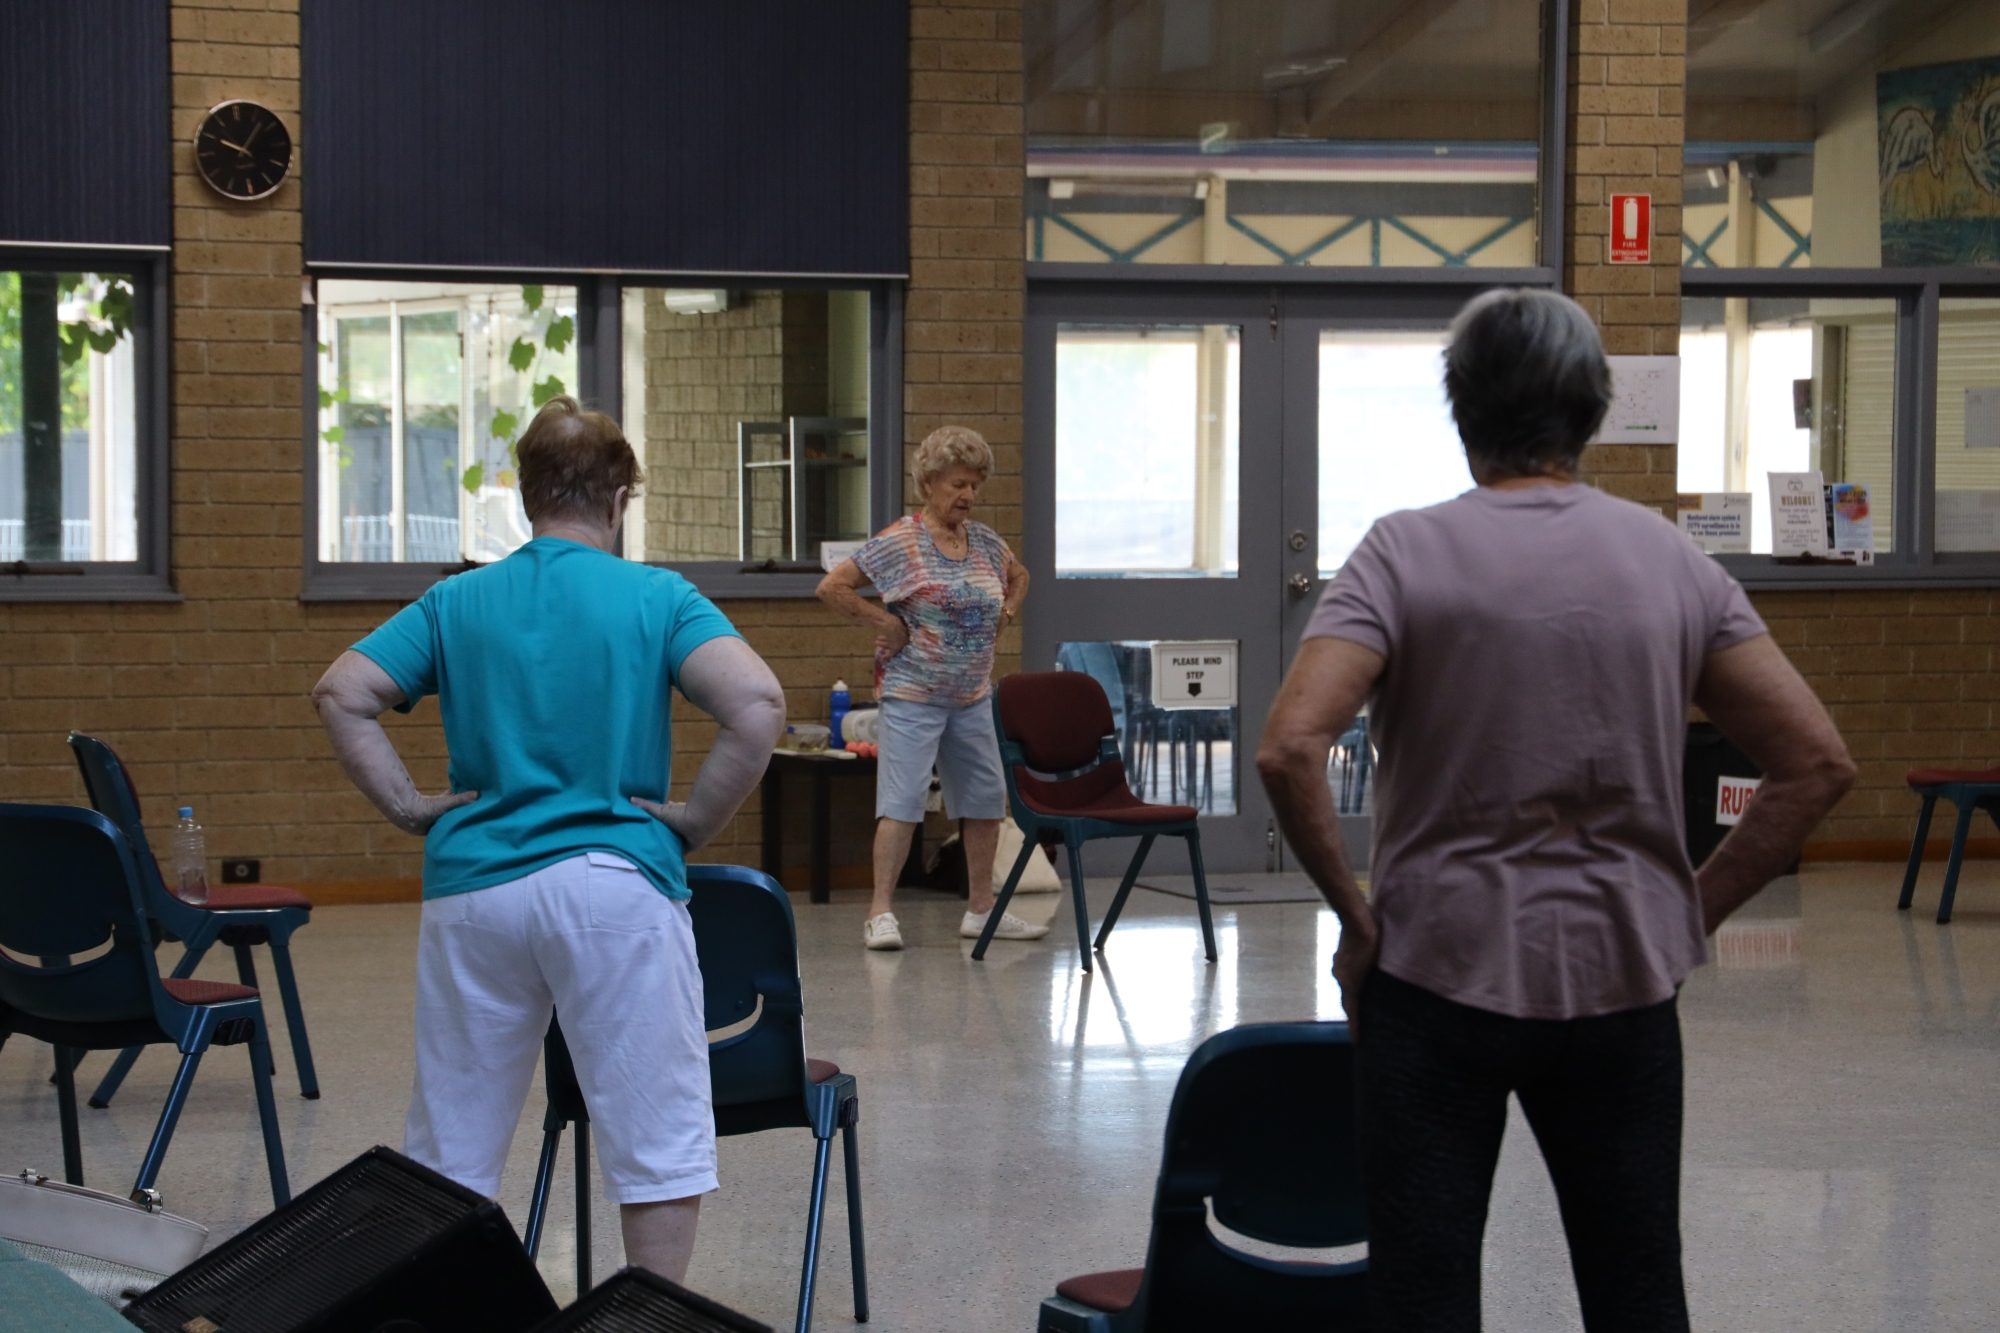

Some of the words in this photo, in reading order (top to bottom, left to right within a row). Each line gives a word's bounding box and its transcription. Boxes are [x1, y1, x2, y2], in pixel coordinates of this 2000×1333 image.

[1708, 513, 1720, 521] alarm
[1721, 514, 1736, 522] system
[1172, 656, 1200, 666] PLEASE
[1203, 656, 1222, 665] MIND
[1186, 671, 1204, 680] STEP
